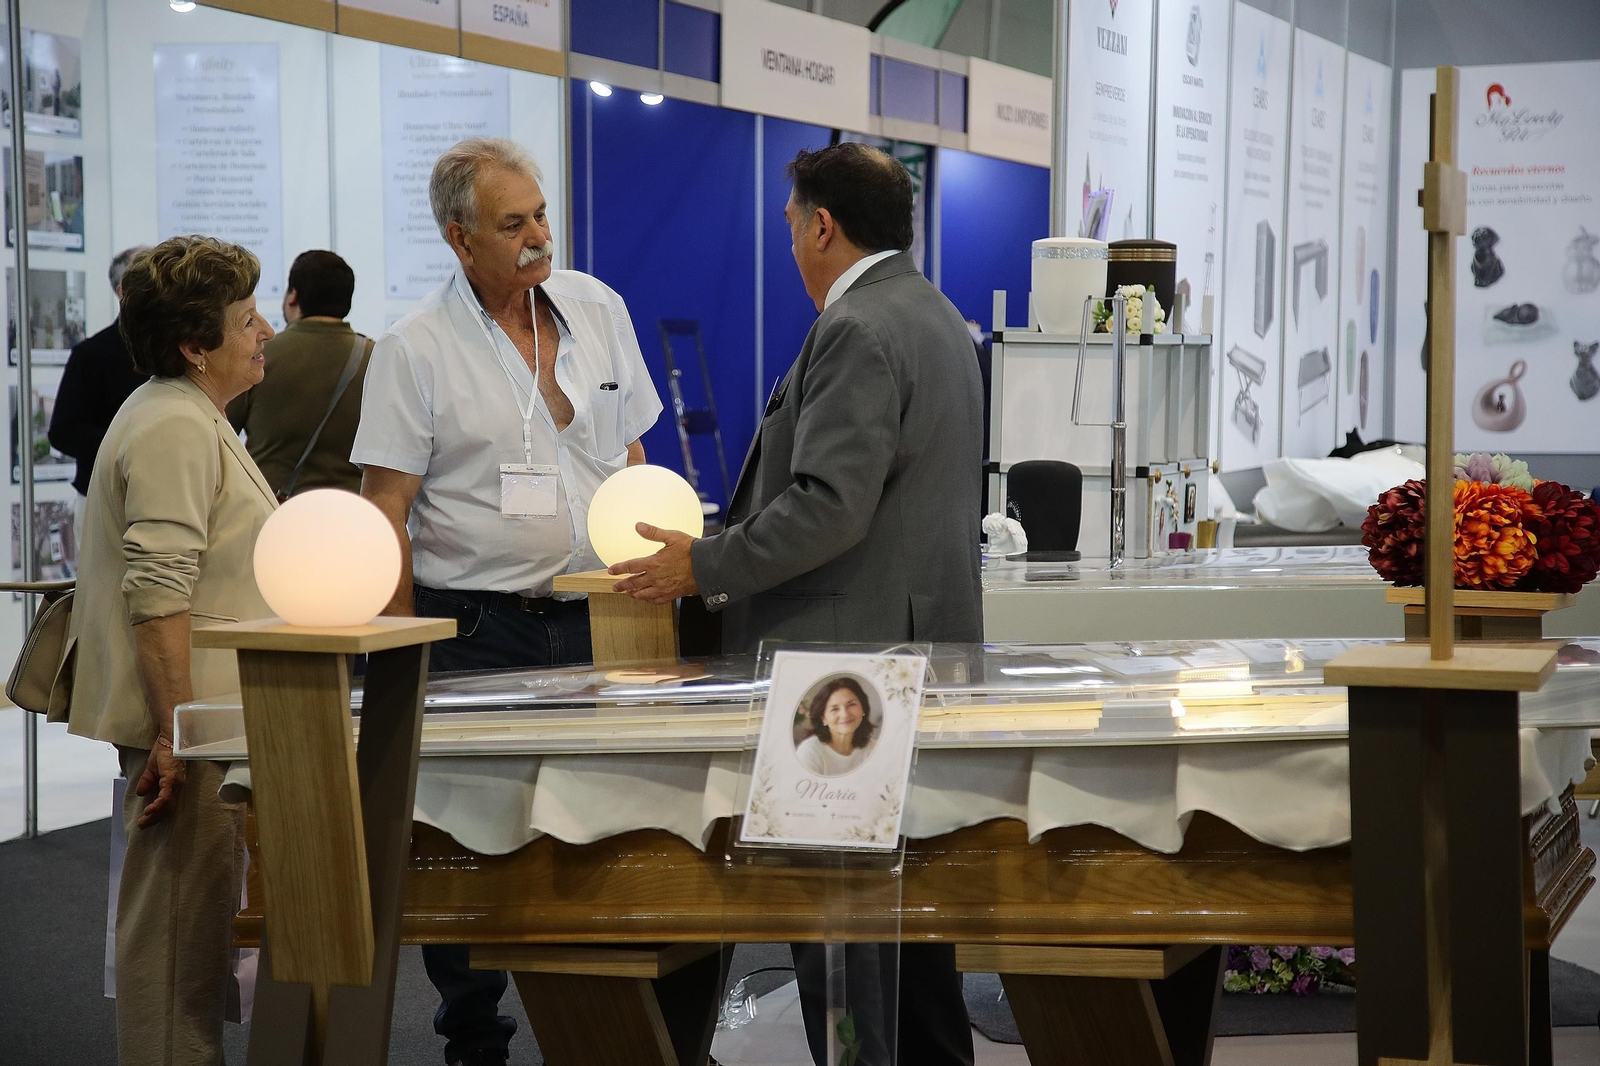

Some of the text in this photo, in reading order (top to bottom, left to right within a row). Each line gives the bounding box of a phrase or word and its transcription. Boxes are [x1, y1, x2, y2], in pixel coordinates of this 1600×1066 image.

[493, 4, 530, 27] ESPAÑA
[760, 48, 836, 87] VENTANA HOGAR
[1472, 163, 1566, 178] Recuerdos eternos
[1499, 184, 1521, 195] para
